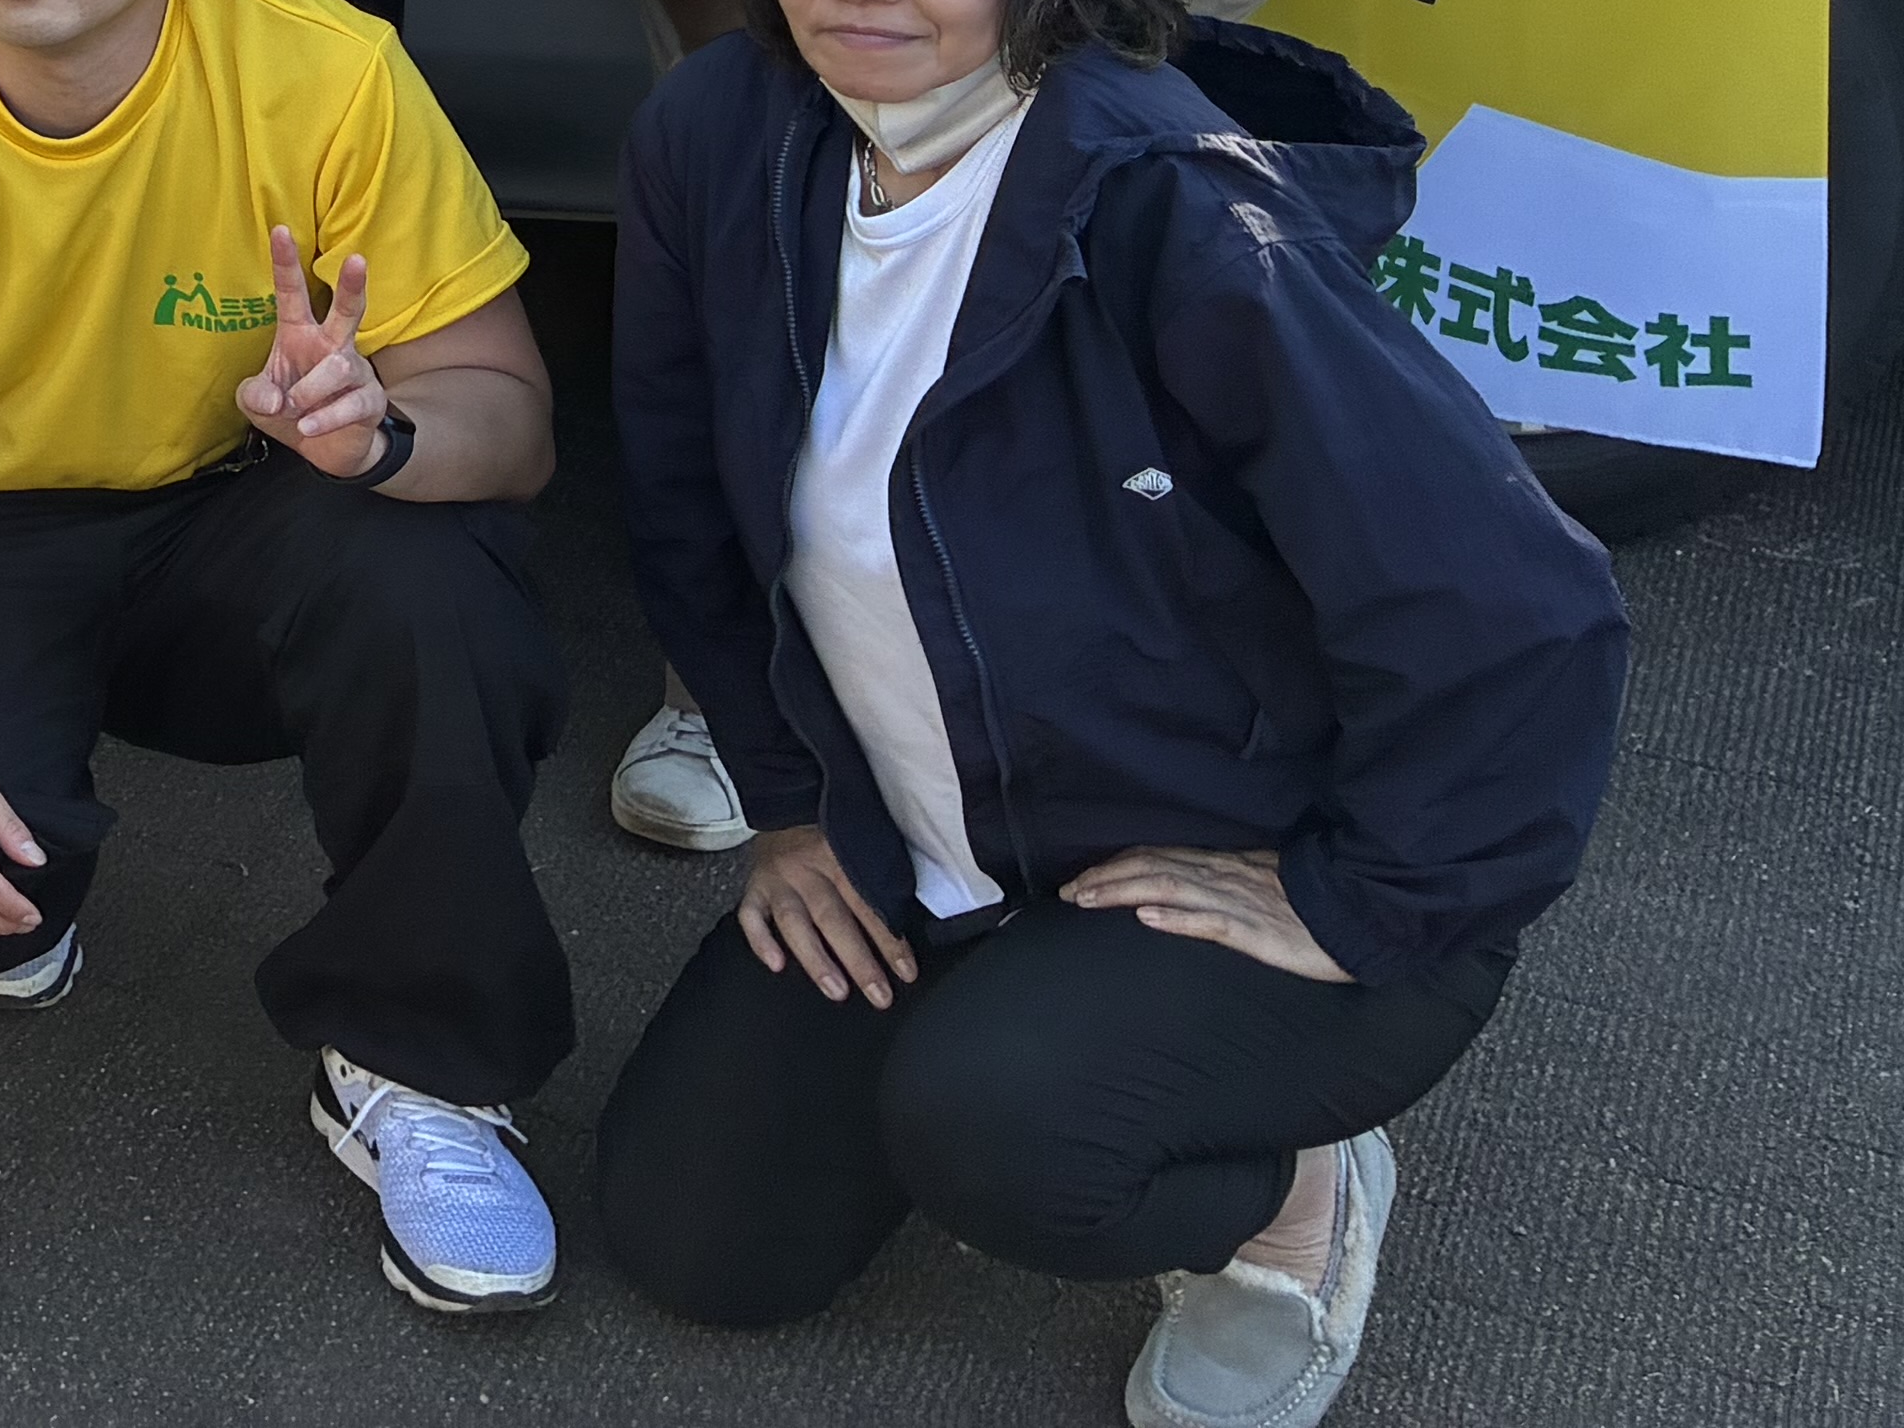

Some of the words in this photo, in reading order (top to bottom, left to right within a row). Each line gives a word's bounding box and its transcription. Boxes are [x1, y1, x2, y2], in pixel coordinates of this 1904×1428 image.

[181, 312, 278, 333] MIMOS
[1369, 234, 1753, 388] 株式会社
